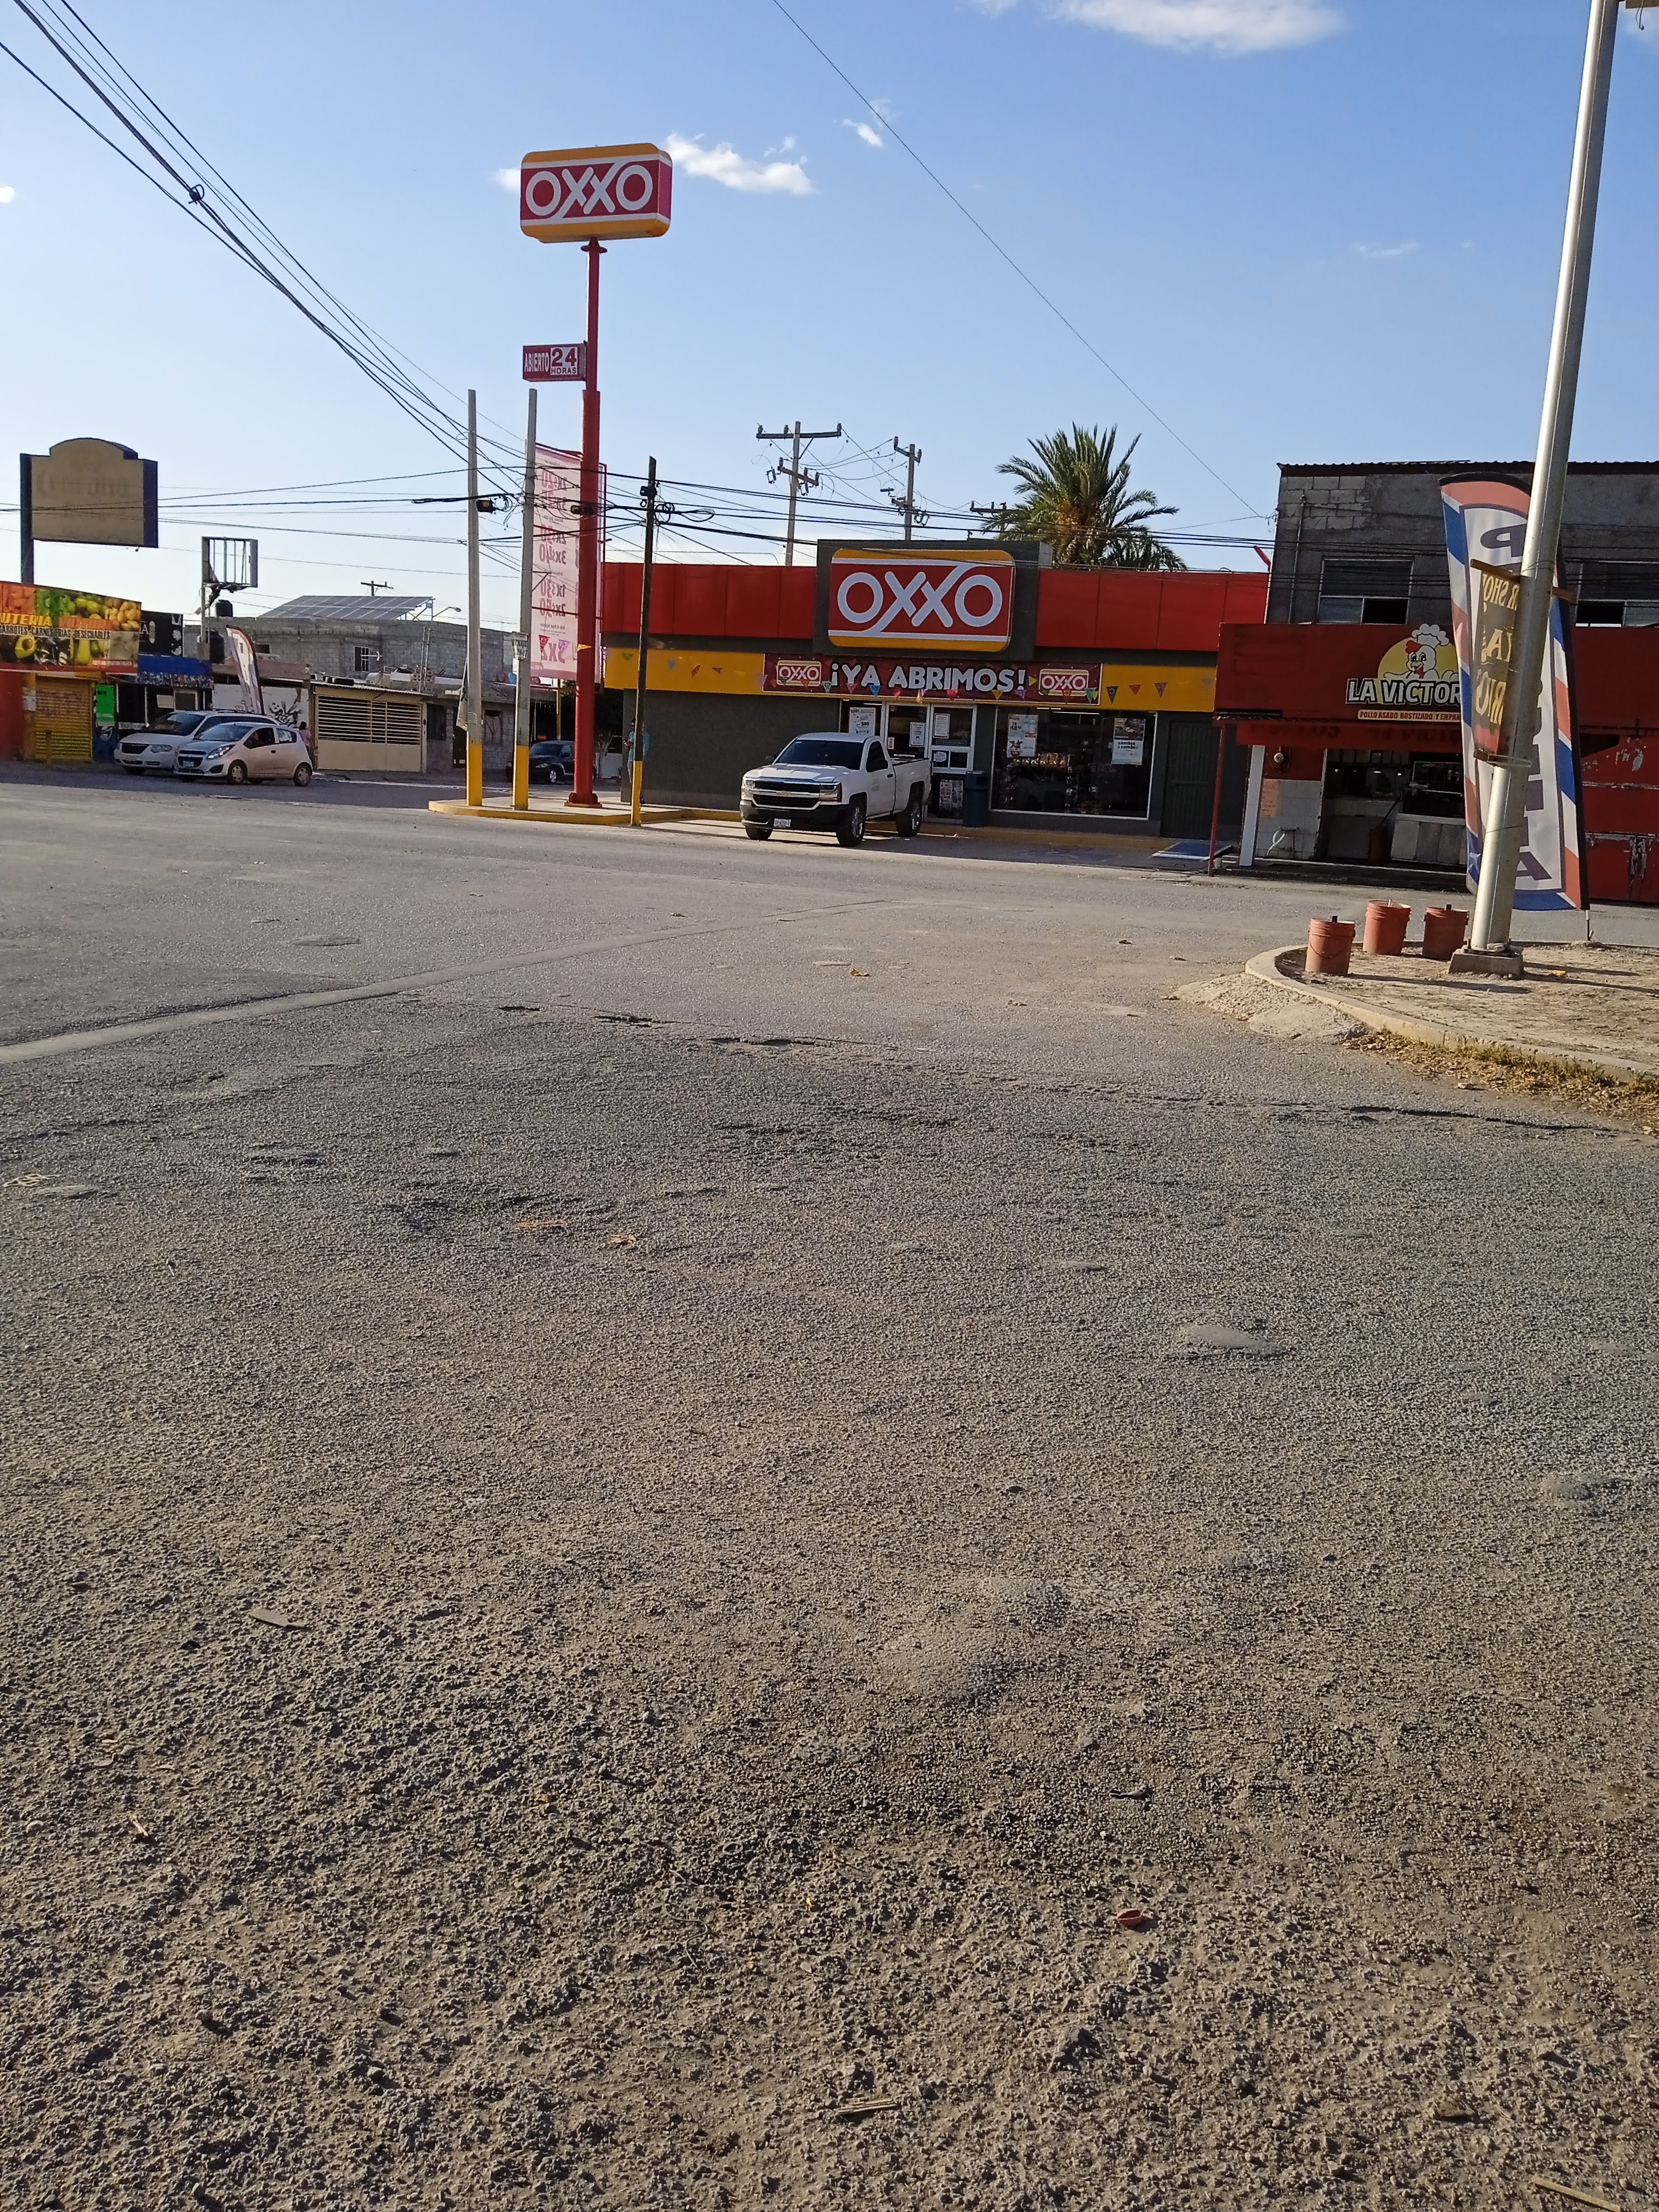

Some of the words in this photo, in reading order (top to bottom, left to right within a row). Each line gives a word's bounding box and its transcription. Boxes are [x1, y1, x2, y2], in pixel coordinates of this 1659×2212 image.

[525, 162, 653, 219] OXXO
[524, 352, 550, 372] ABIERTO
[551, 348, 577, 367] 24
[837, 568, 1003, 631] OXXO
[0, 612, 53, 626] UTERIA
[778, 665, 819, 681] OXXO
[832, 663, 881, 687] ¡YA
[888, 666, 1026, 692] ABRIMOS!
[1041, 674, 1086, 691] OXXO
[1346, 678, 1378, 704] LA
